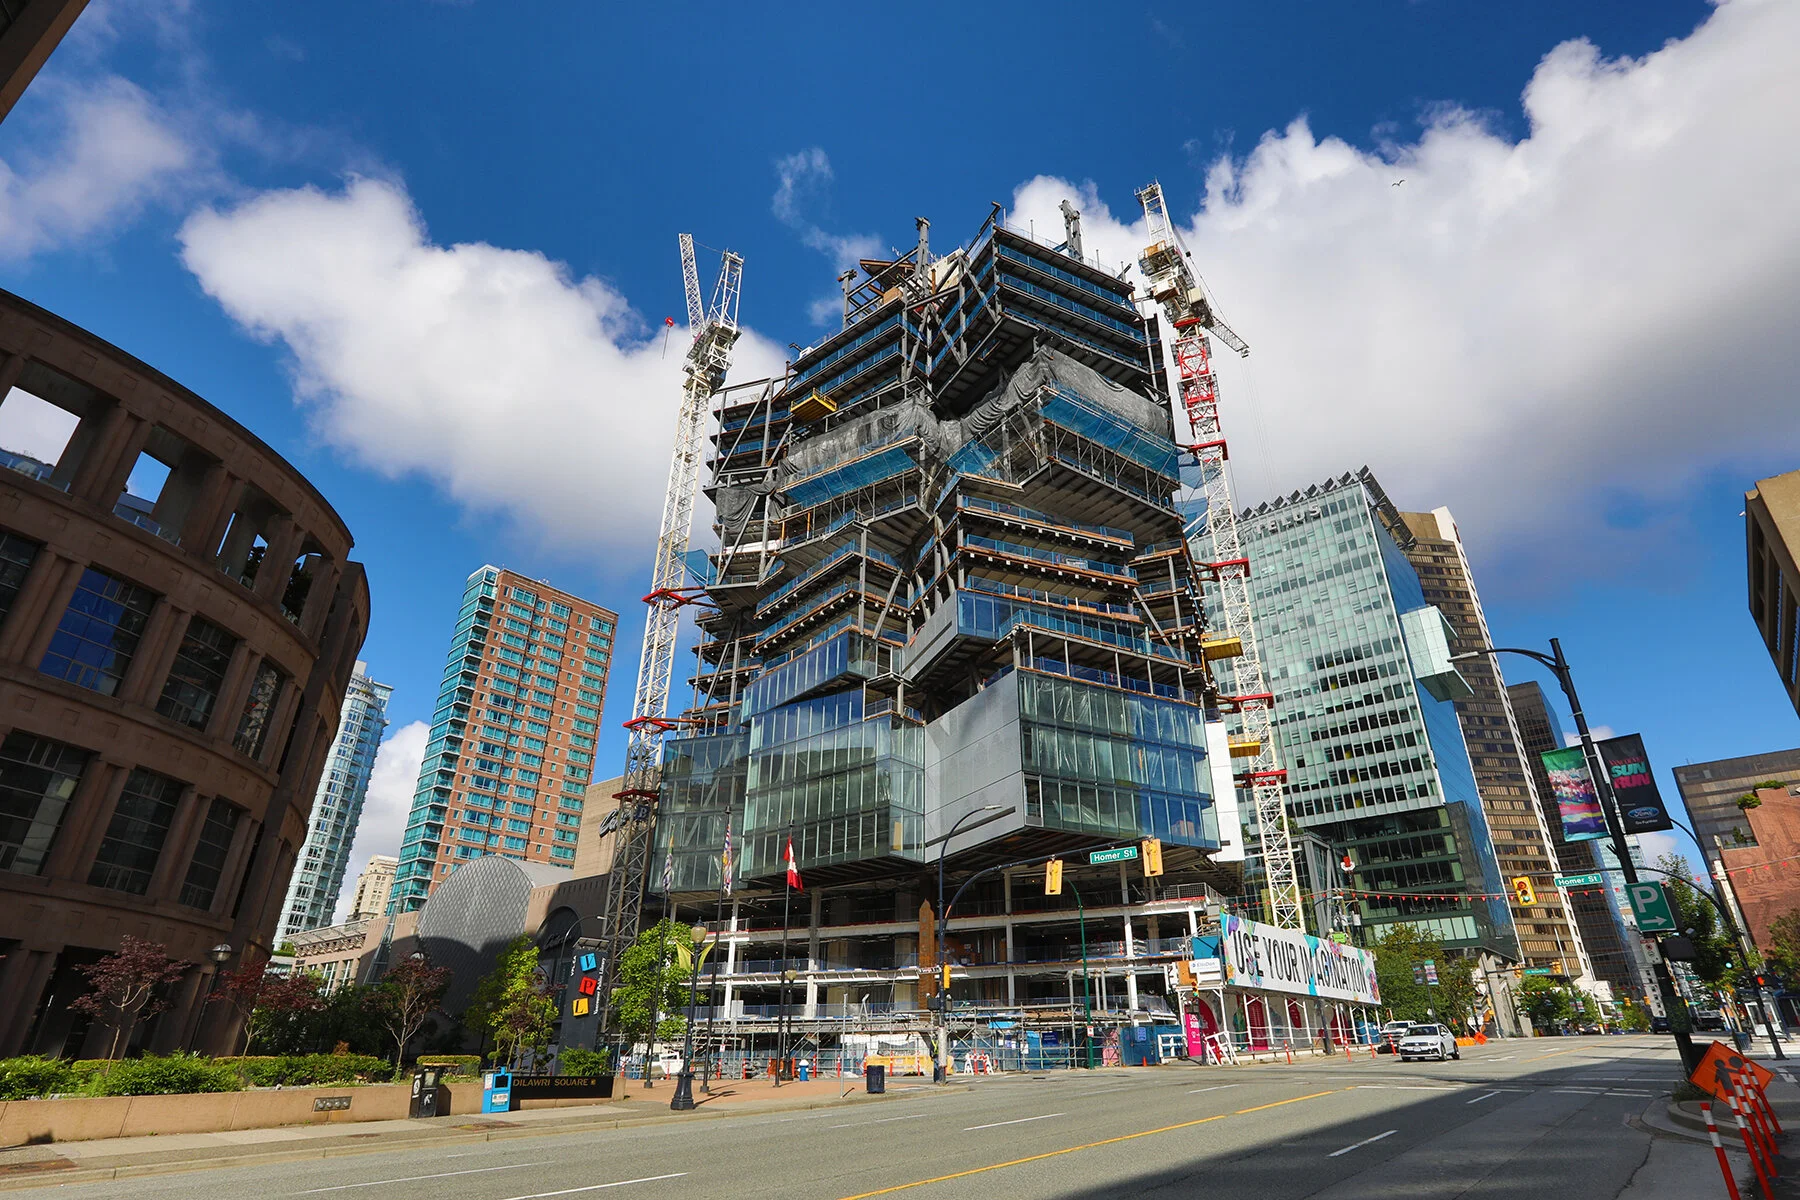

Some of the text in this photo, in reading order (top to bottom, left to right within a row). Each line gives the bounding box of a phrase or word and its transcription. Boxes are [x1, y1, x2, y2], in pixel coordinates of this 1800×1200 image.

[1611, 762, 1647, 778] SUN
[1613, 773, 1651, 789] RUN
[1094, 849, 1133, 861] Homer St
[1558, 875, 1598, 886] Homer St
[1631, 886, 1659, 913] P
[1232, 930, 1368, 994] USE YOUR IMAGINATION
[512, 1078, 589, 1087] DILAWRI SQUARE
